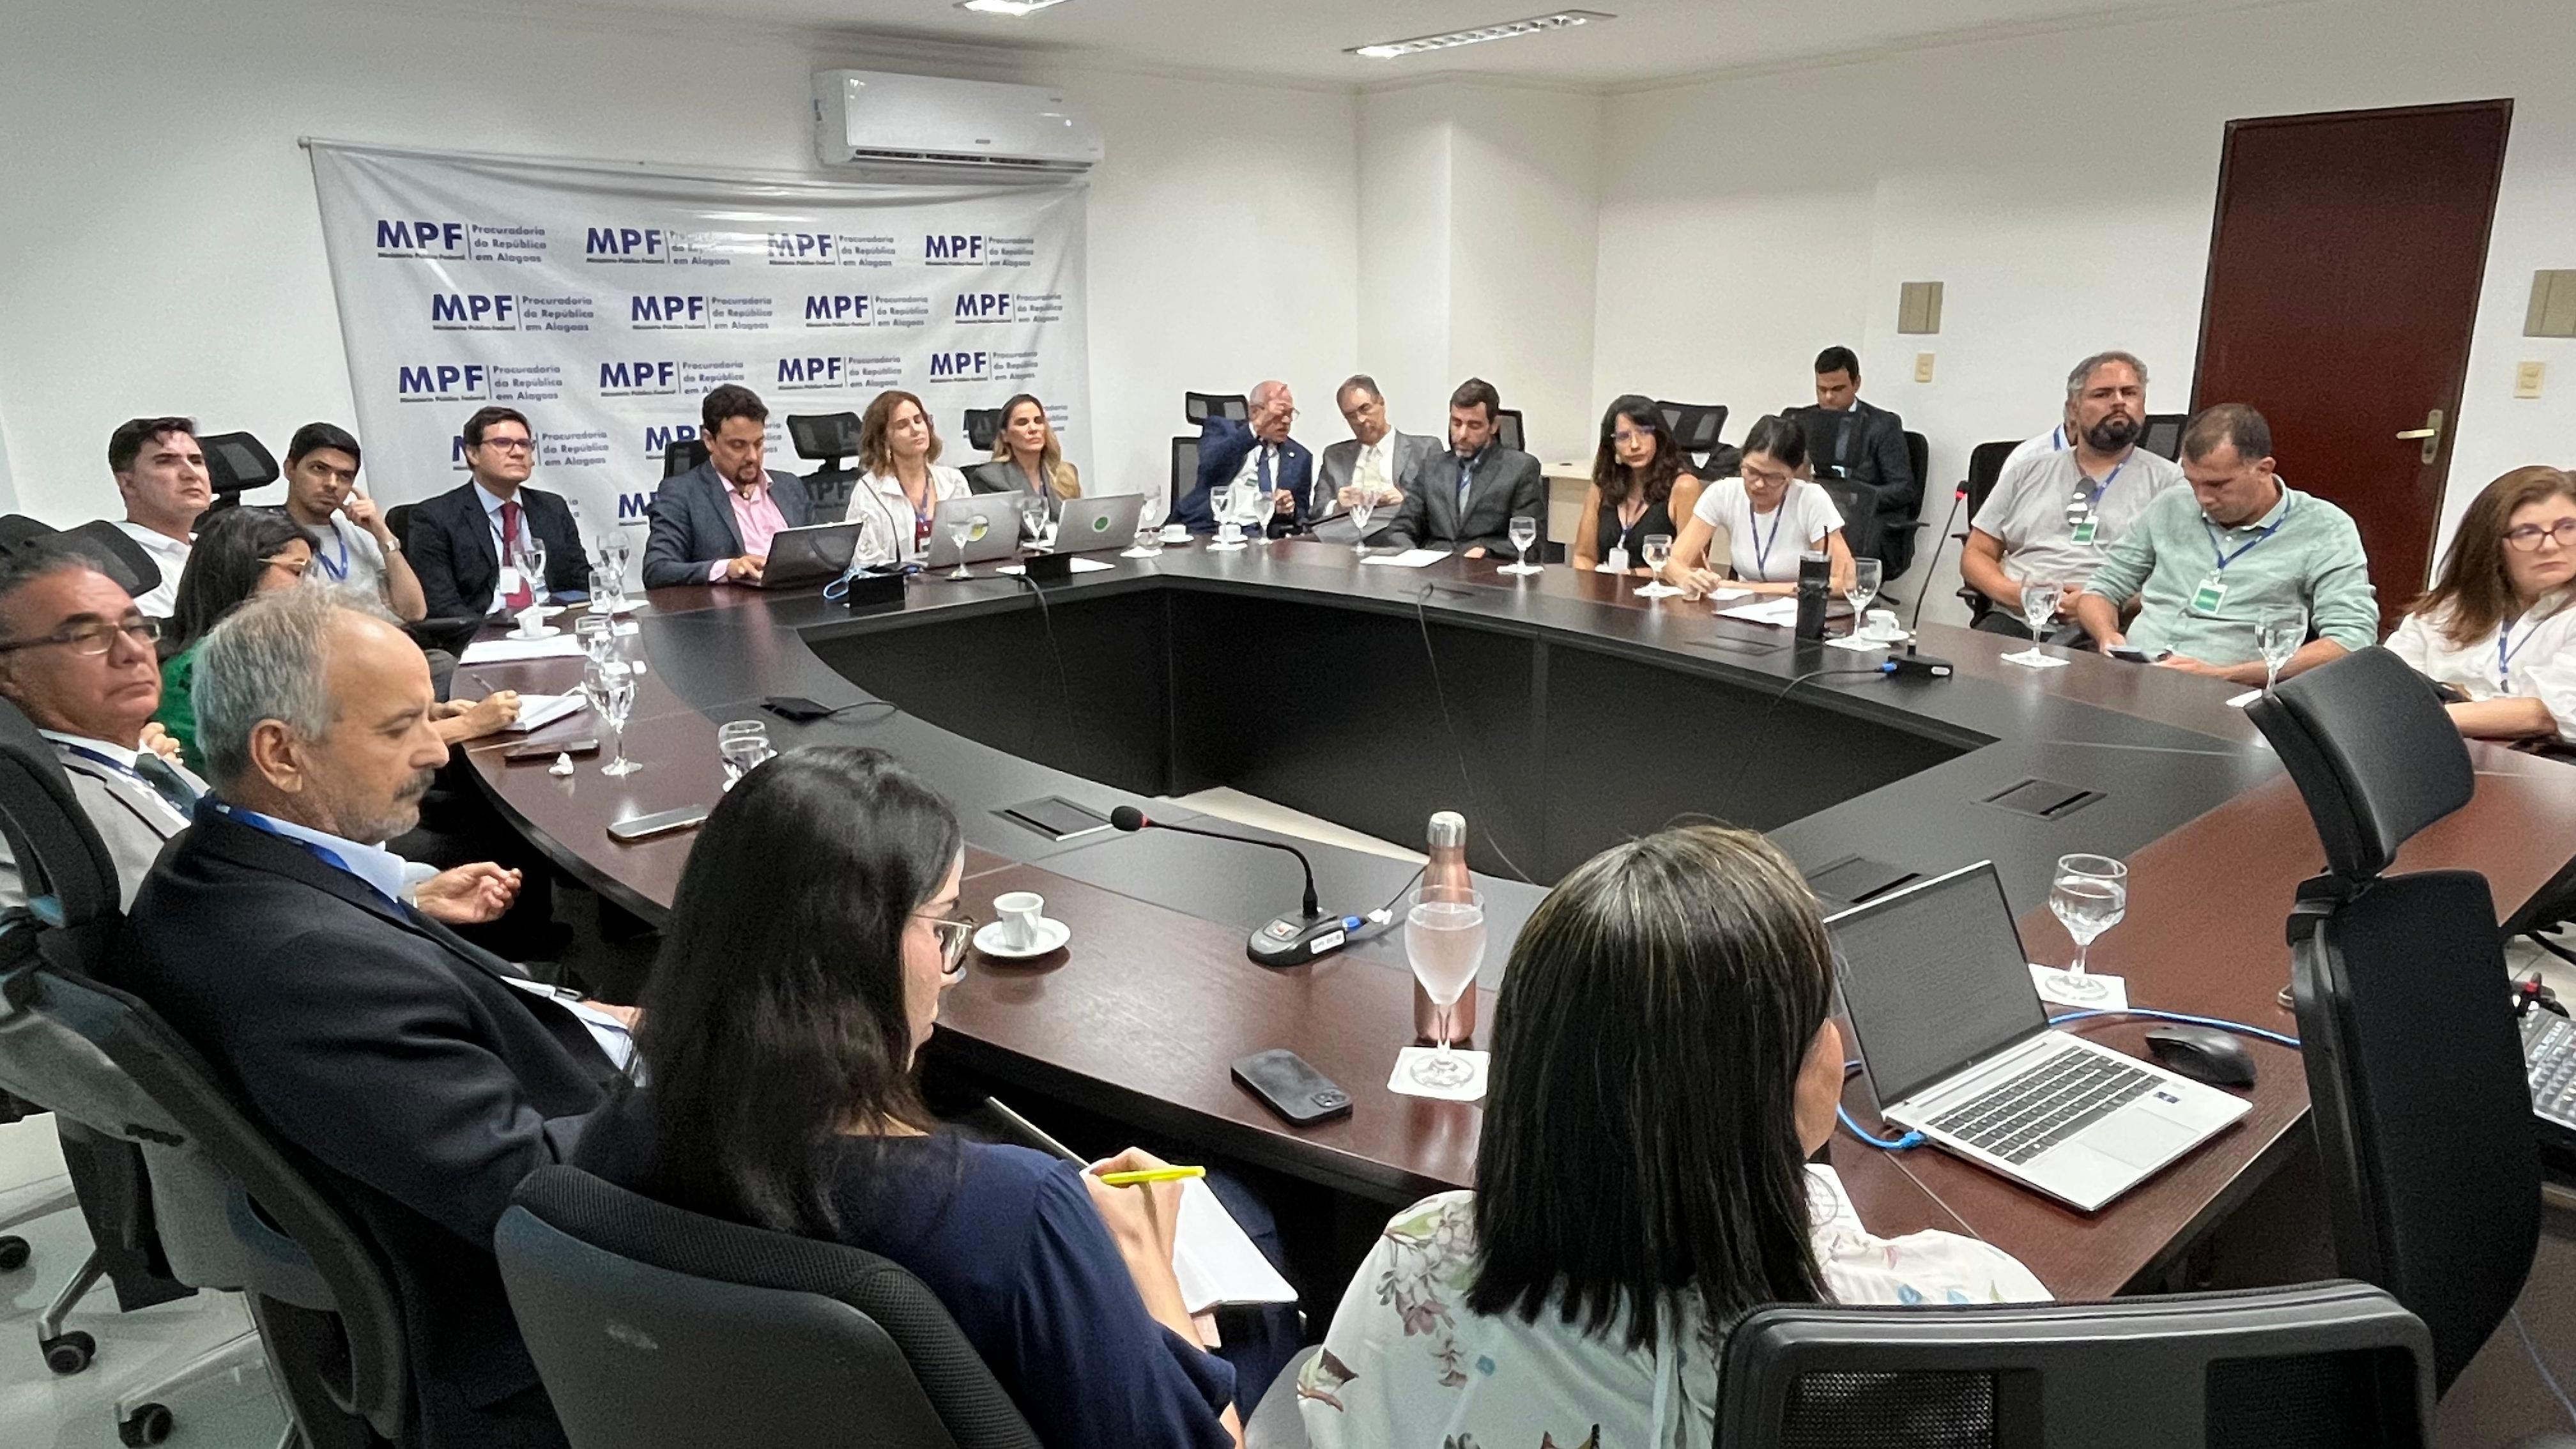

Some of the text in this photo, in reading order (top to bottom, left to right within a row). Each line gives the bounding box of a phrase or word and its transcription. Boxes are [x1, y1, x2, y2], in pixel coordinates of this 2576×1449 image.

[377, 220, 462, 250] MPF
[472, 224, 545, 235] Procuradoria
[475, 238, 487, 247] da
[586, 228, 662, 254] MPF
[768, 233, 832, 256] MPF
[926, 235, 981, 257] MPF
[498, 254, 541, 264] Alagoas
[433, 294, 512, 321] MPF
[523, 296, 592, 305] Procuradoria
[632, 296, 703, 321] MPF
[806, 296, 868, 319] MPF
[955, 294, 1009, 316] MPF
[525, 309, 537, 318] da
[546, 323, 588, 332] Alagoas
[493, 365, 560, 374] Procuradoria
[682, 361, 744, 369] Procuradoria
[778, 357, 841, 381] MPF
[930, 352, 986, 375] MPF
[399, 365, 482, 393] MPF
[494, 378, 509, 387] da
[600, 362, 673, 388] MPF
[517, 391, 558, 401] Alagoas
[542, 431, 607, 441] Procuradoria
[645, 425, 698, 452] MP
[544, 444, 556, 453] da
[565, 457, 606, 466] Alagoas
